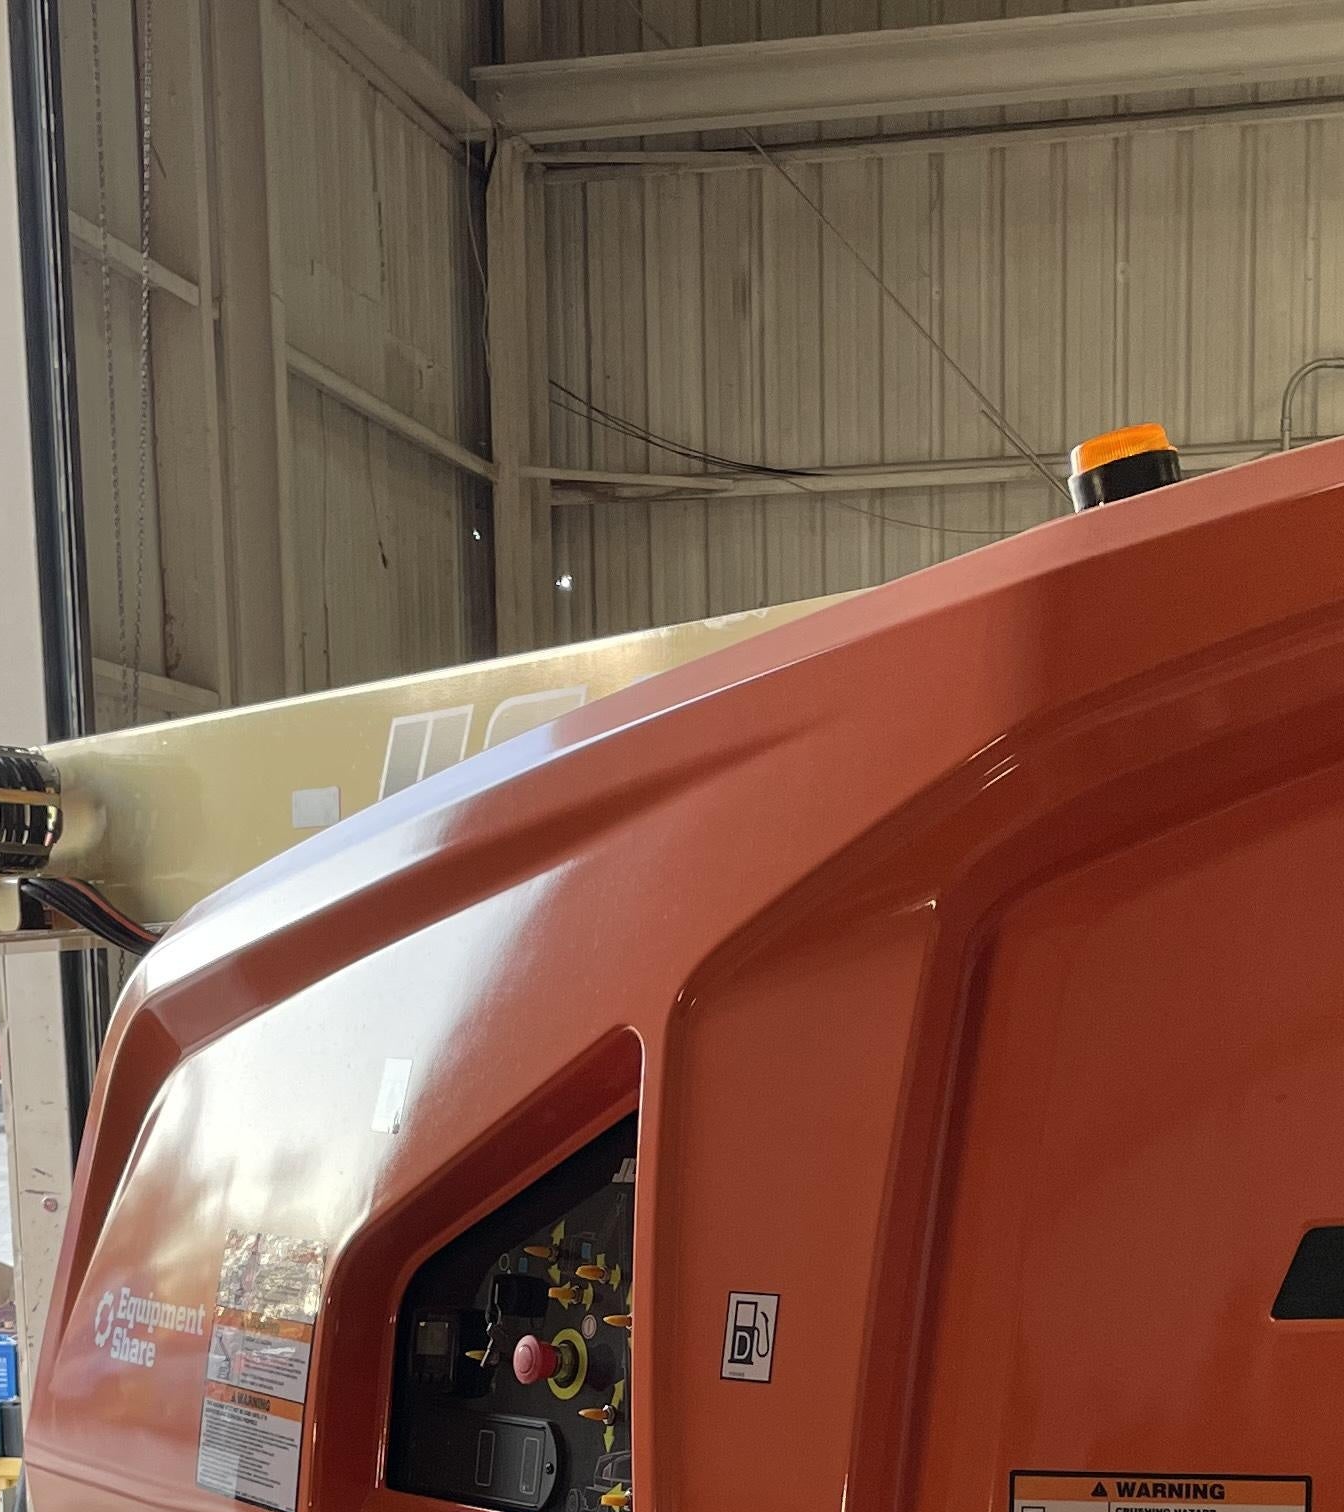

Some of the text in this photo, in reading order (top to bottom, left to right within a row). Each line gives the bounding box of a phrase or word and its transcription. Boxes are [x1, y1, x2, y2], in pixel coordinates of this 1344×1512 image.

[116, 1287, 205, 1335] Equipment
[110, 1326, 156, 1368] Share
[1116, 1481, 1226, 1500] WARNING
